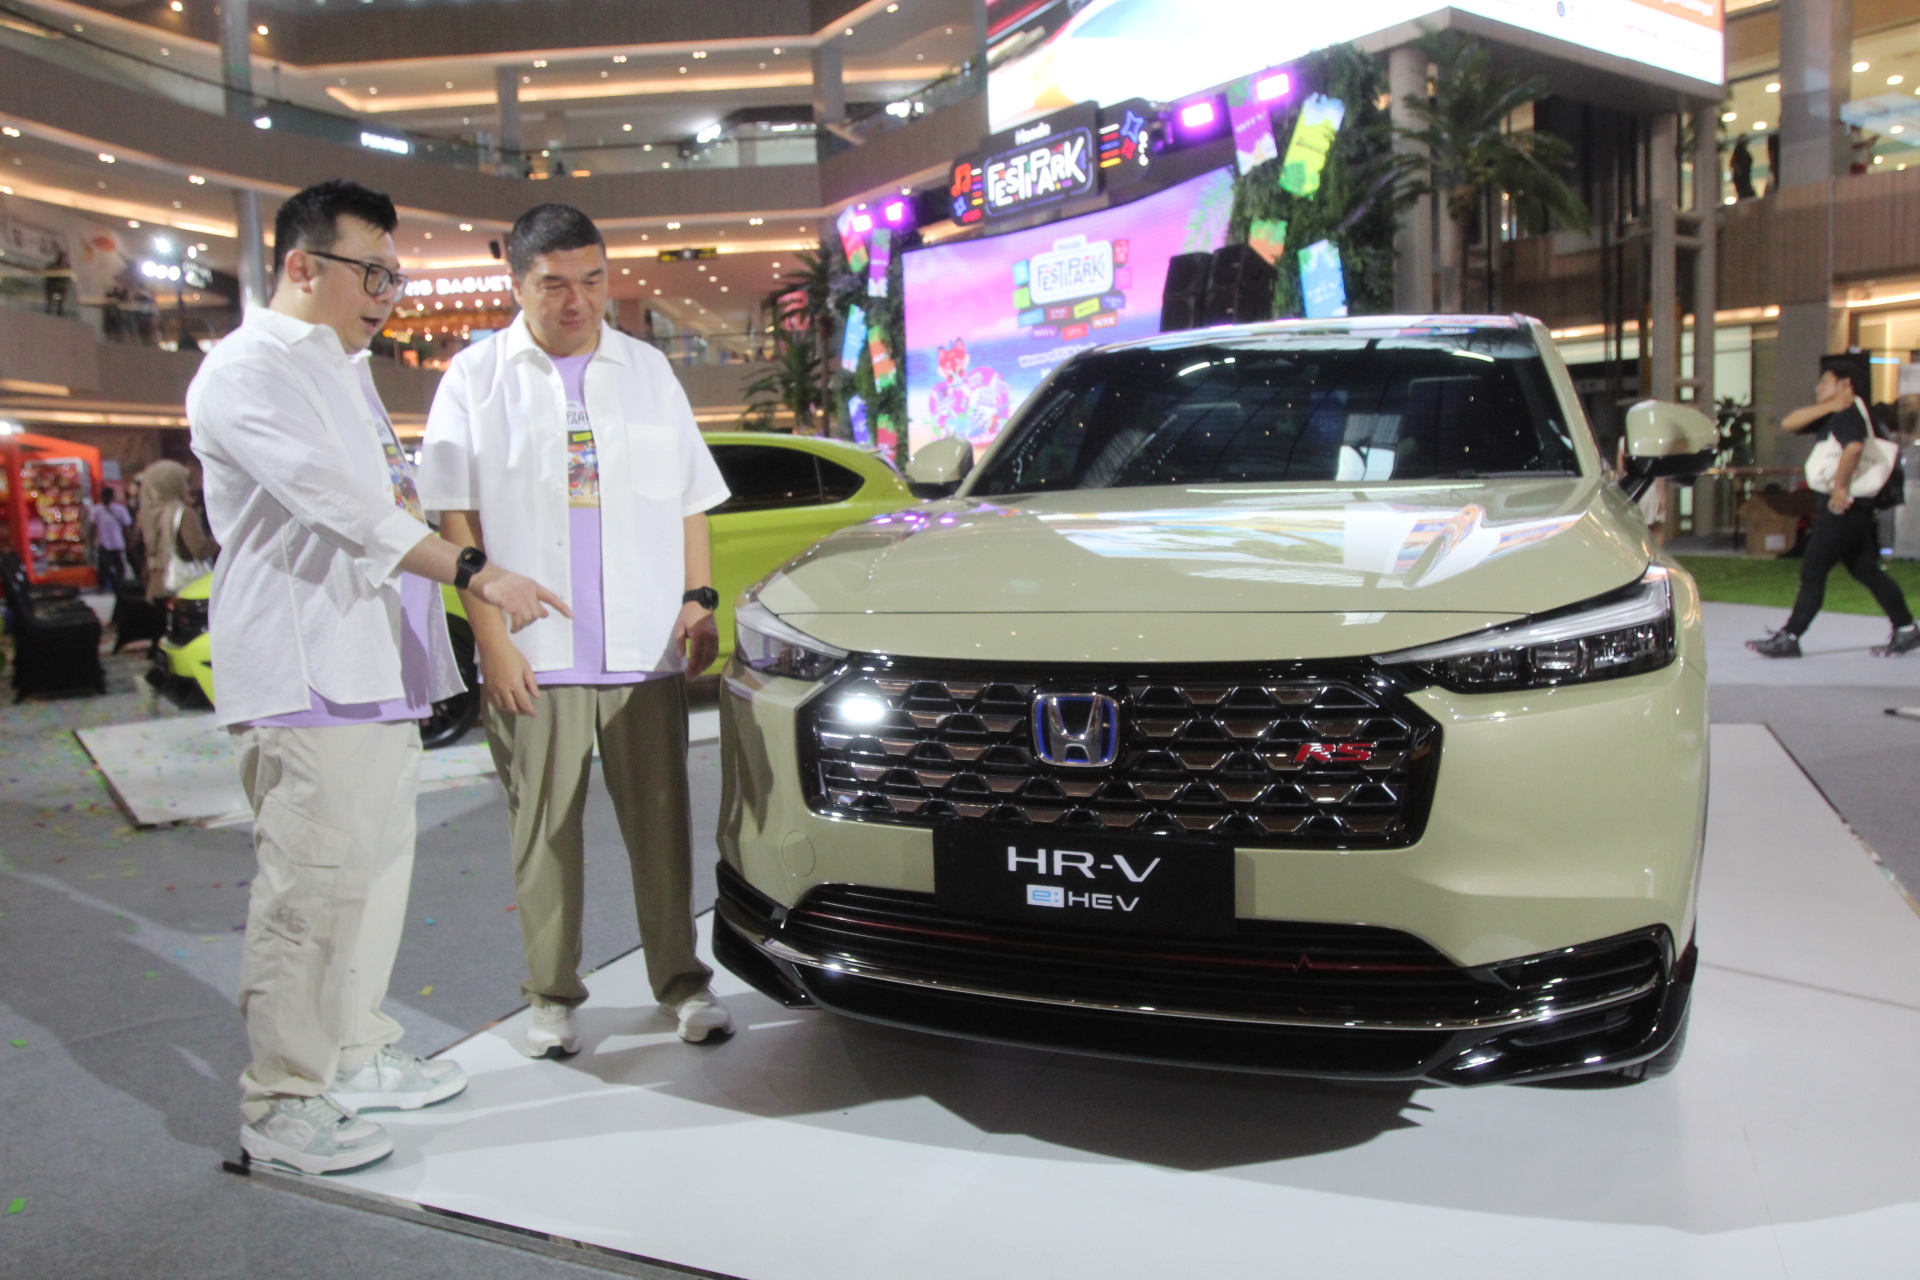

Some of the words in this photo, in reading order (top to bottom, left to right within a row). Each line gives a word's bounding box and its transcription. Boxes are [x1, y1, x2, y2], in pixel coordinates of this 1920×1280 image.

[1015, 121, 1051, 146] Honda
[435, 274, 512, 296] BAGUET
[1294, 743, 1376, 762] RS
[1007, 846, 1161, 883] HR-V
